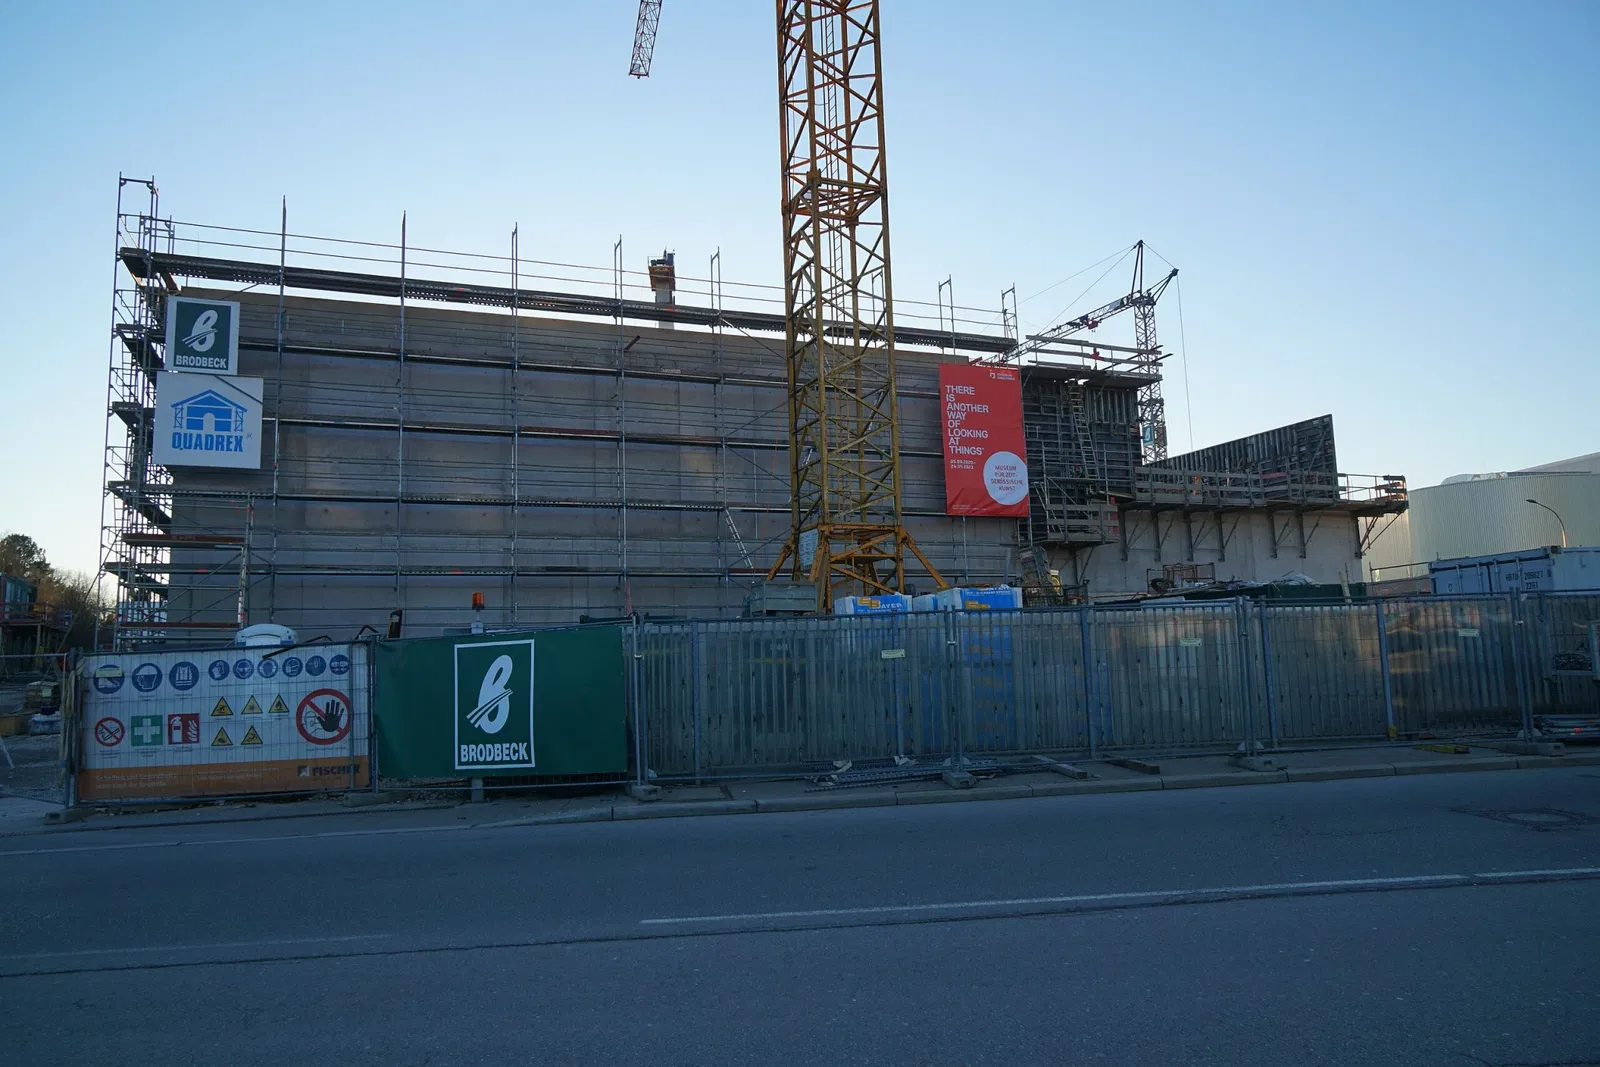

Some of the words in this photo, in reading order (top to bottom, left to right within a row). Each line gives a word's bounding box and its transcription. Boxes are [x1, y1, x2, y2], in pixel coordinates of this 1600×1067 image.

[176, 354, 227, 369] BRODBECK
[945, 384, 975, 395] THERE
[946, 393, 956, 402] IS
[946, 402, 989, 413] ANOTHER
[947, 411, 967, 420] WAY
[947, 419, 961, 428] OF
[948, 428, 989, 439] LOOKING
[171, 431, 244, 452] QUADREX
[948, 437, 960, 446] AT
[460, 742, 529, 762] BRODBECK
